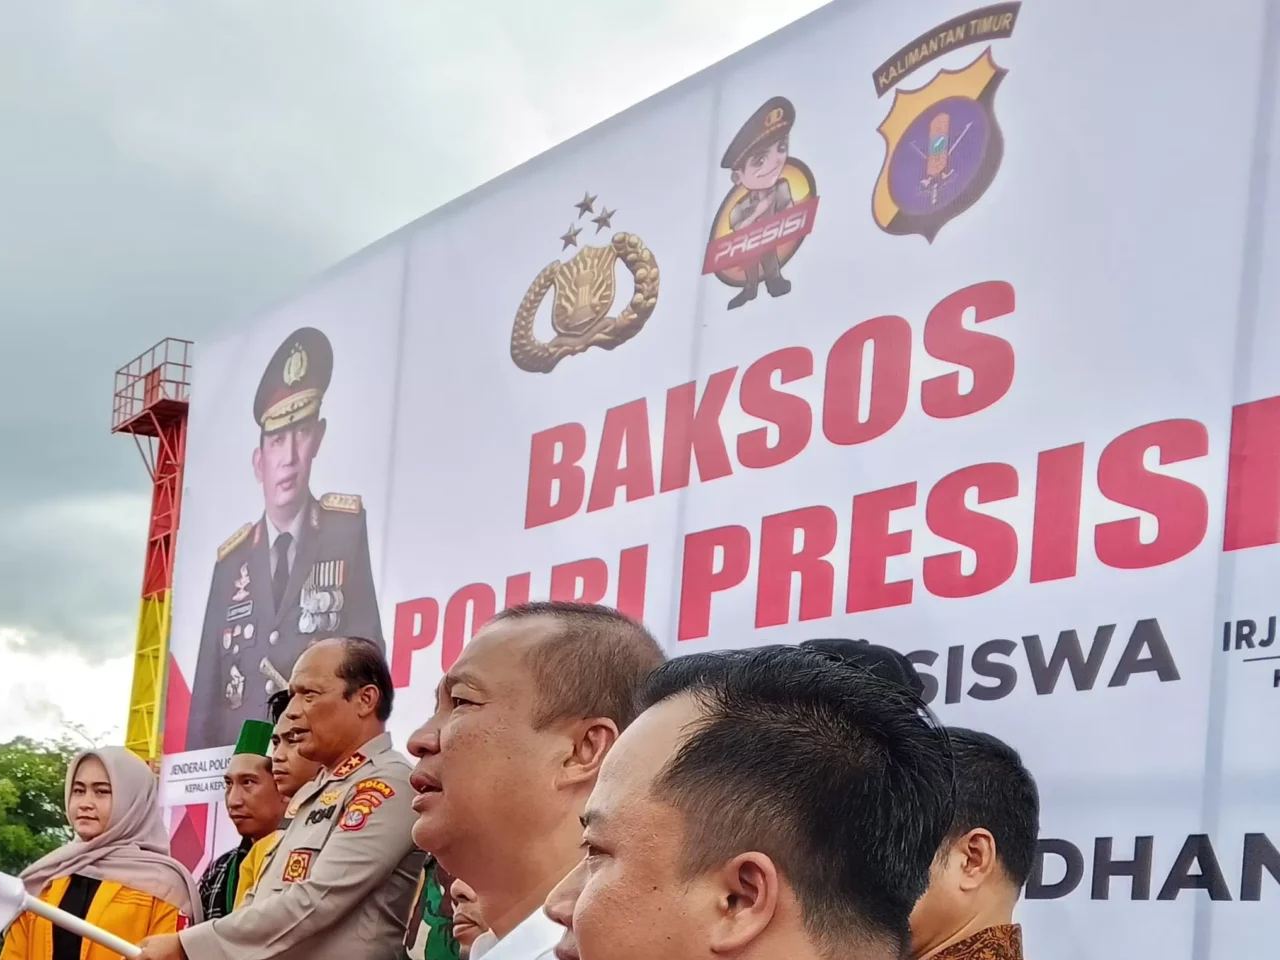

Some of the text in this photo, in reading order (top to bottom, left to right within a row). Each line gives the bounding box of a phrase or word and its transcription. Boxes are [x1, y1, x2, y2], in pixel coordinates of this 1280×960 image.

[878, 13, 1013, 88] KALIMANTAN TIMUR
[714, 209, 807, 263] PRESISI
[524, 280, 1016, 529] BAKSOS
[677, 395, 1280, 640] PRESISI
[171, 761, 208, 775] JENDERAL
[185, 782, 209, 793] KEPALA
[358, 780, 391, 796] POLDA
